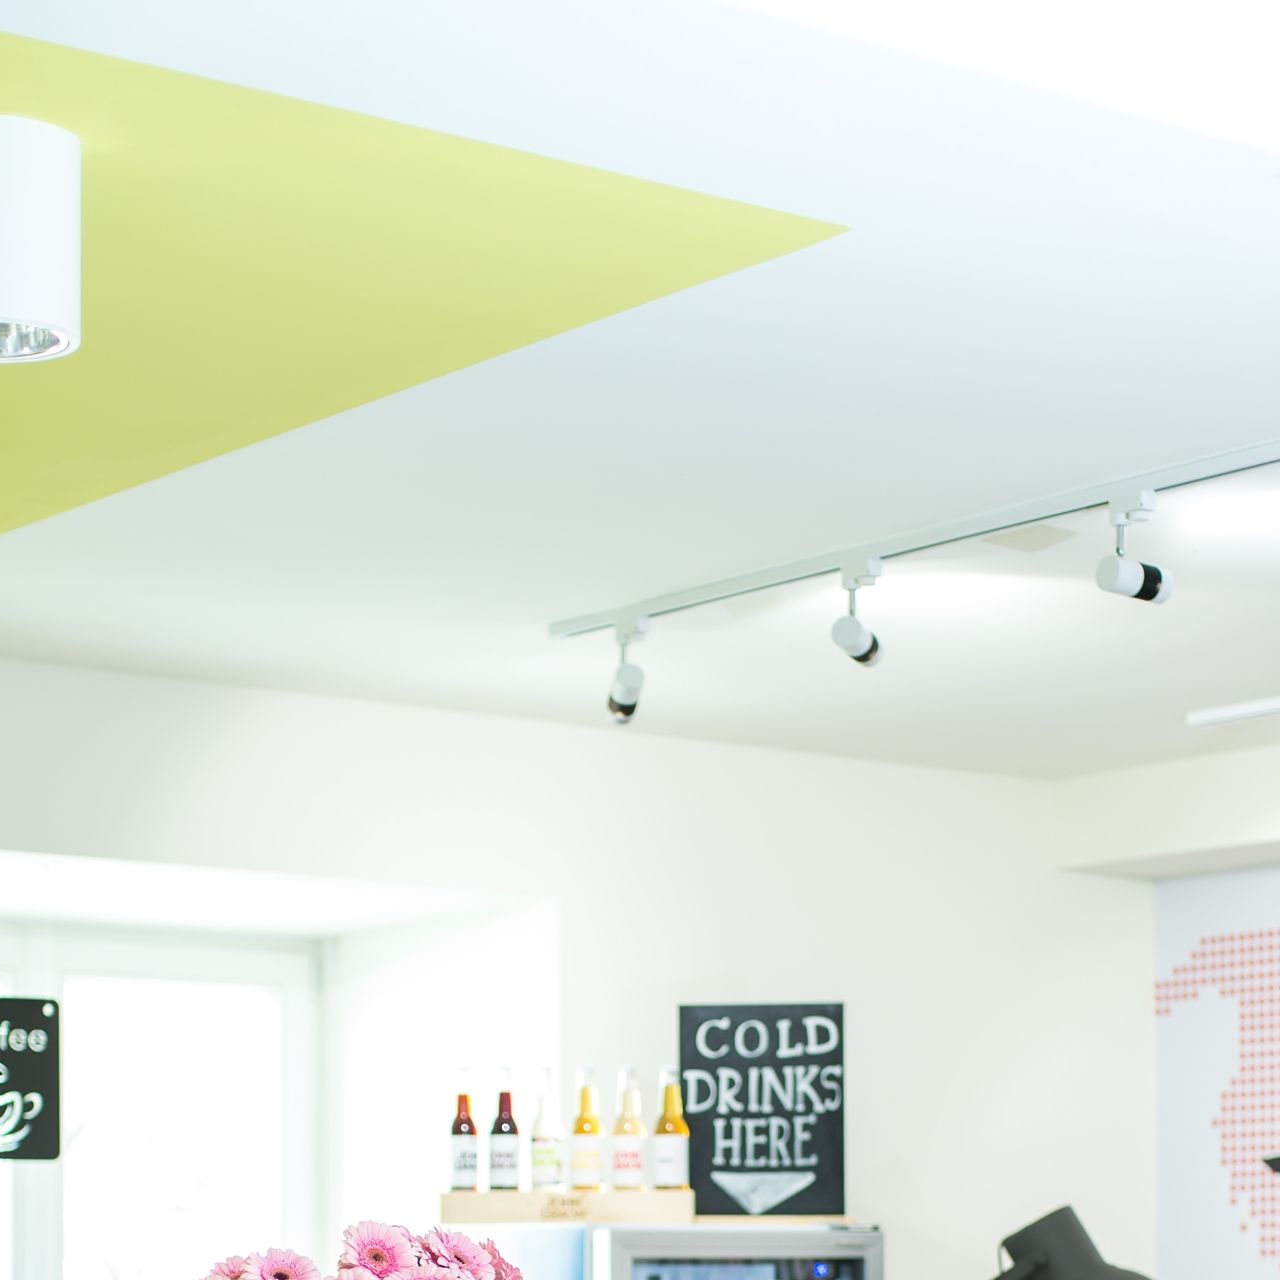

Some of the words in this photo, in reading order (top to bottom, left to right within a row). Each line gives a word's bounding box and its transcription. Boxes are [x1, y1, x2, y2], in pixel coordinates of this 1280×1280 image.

[695, 1015, 840, 1059] COLD
[682, 1064, 842, 1115] DRINKS
[712, 1114, 818, 1168] HERE
